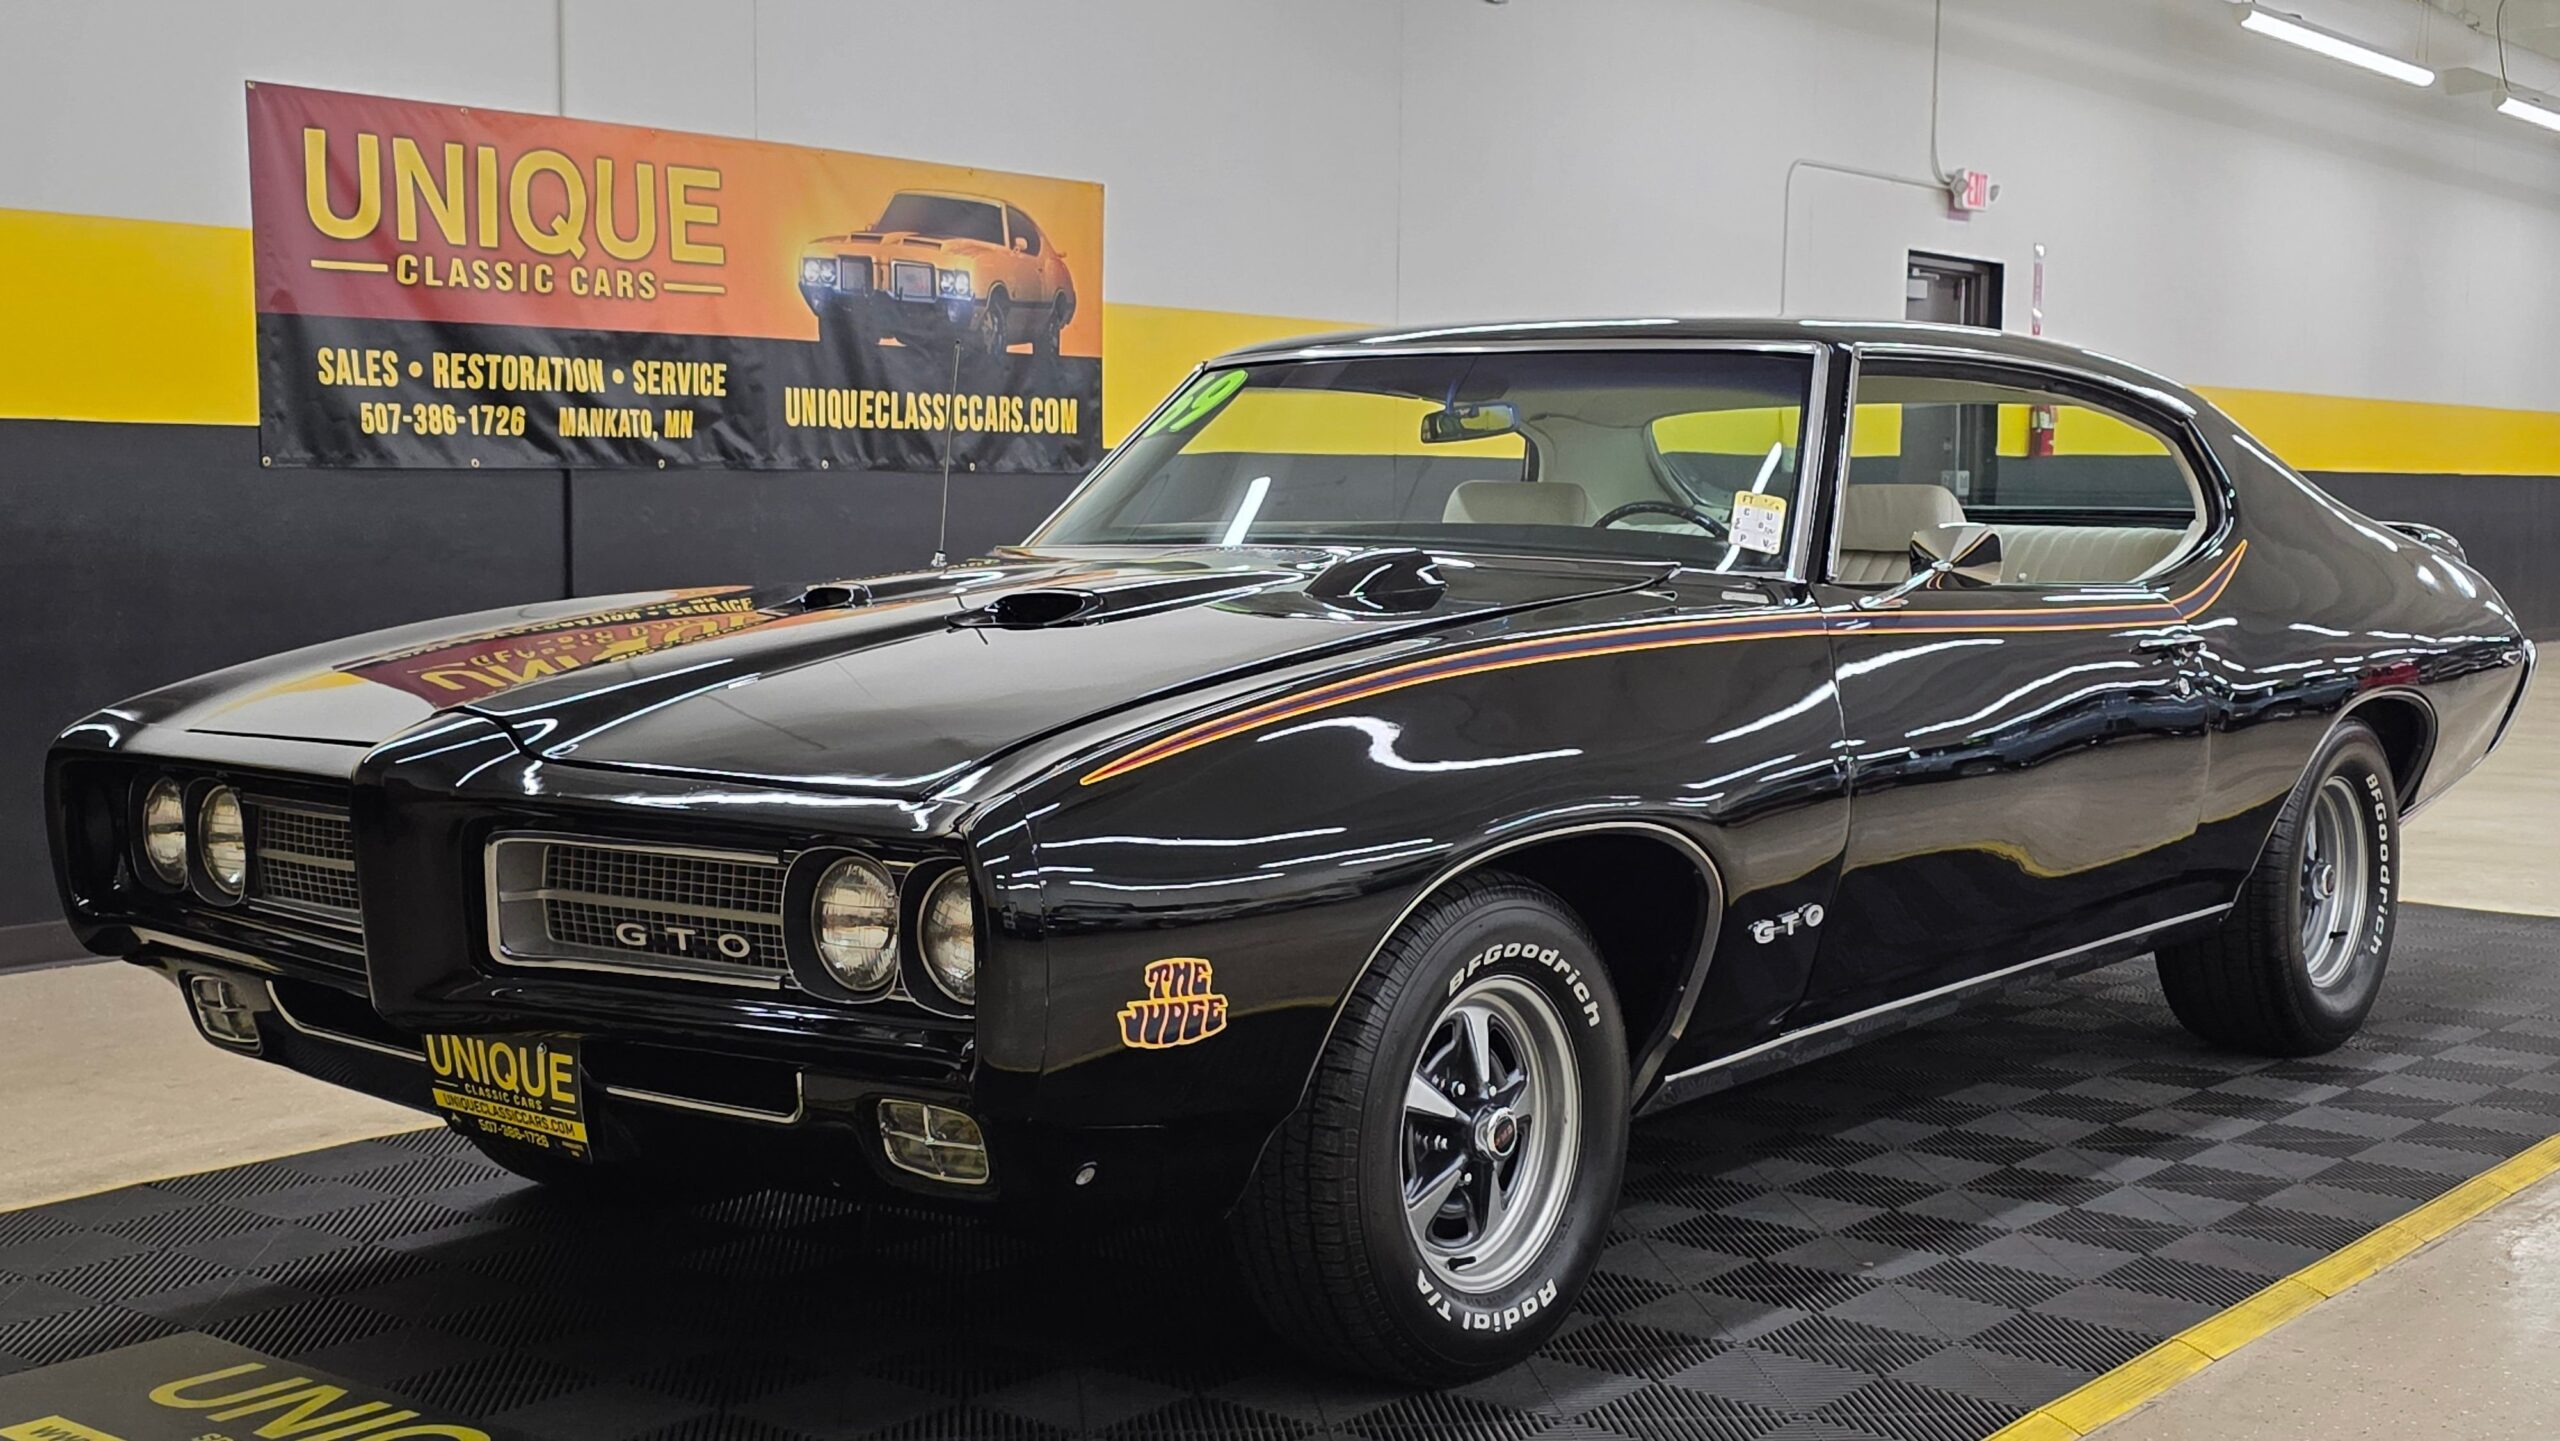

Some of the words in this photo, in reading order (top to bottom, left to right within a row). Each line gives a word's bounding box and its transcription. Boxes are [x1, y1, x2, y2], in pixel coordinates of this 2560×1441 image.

[304, 127, 725, 264] UNIQUE
[396, 255, 553, 293] CLASSIC
[571, 265, 656, 299] CARS
[317, 346, 398, 387] SALES
[432, 352, 605, 394] RESTORATION
[632, 358, 727, 397] SERVICE
[360, 401, 525, 436] 507-386-1726
[664, 409, 694, 438] MN
[2366, 773, 2390, 954] BFGoodrich
[1753, 904, 1824, 944] GTO
[1148, 961, 1209, 999] THE
[1449, 943, 1600, 1027] BFGoodrich
[1122, 997, 1225, 1045] JUDGE
[426, 1034, 576, 1104] UNIQUE
[443, 1092, 576, 1137] UNIQUECLASSICCARS.COM
[465, 1083, 511, 1104] CLASSIC
[514, 1093, 543, 1111] CARS
[1462, 1279, 1558, 1333] Radial
